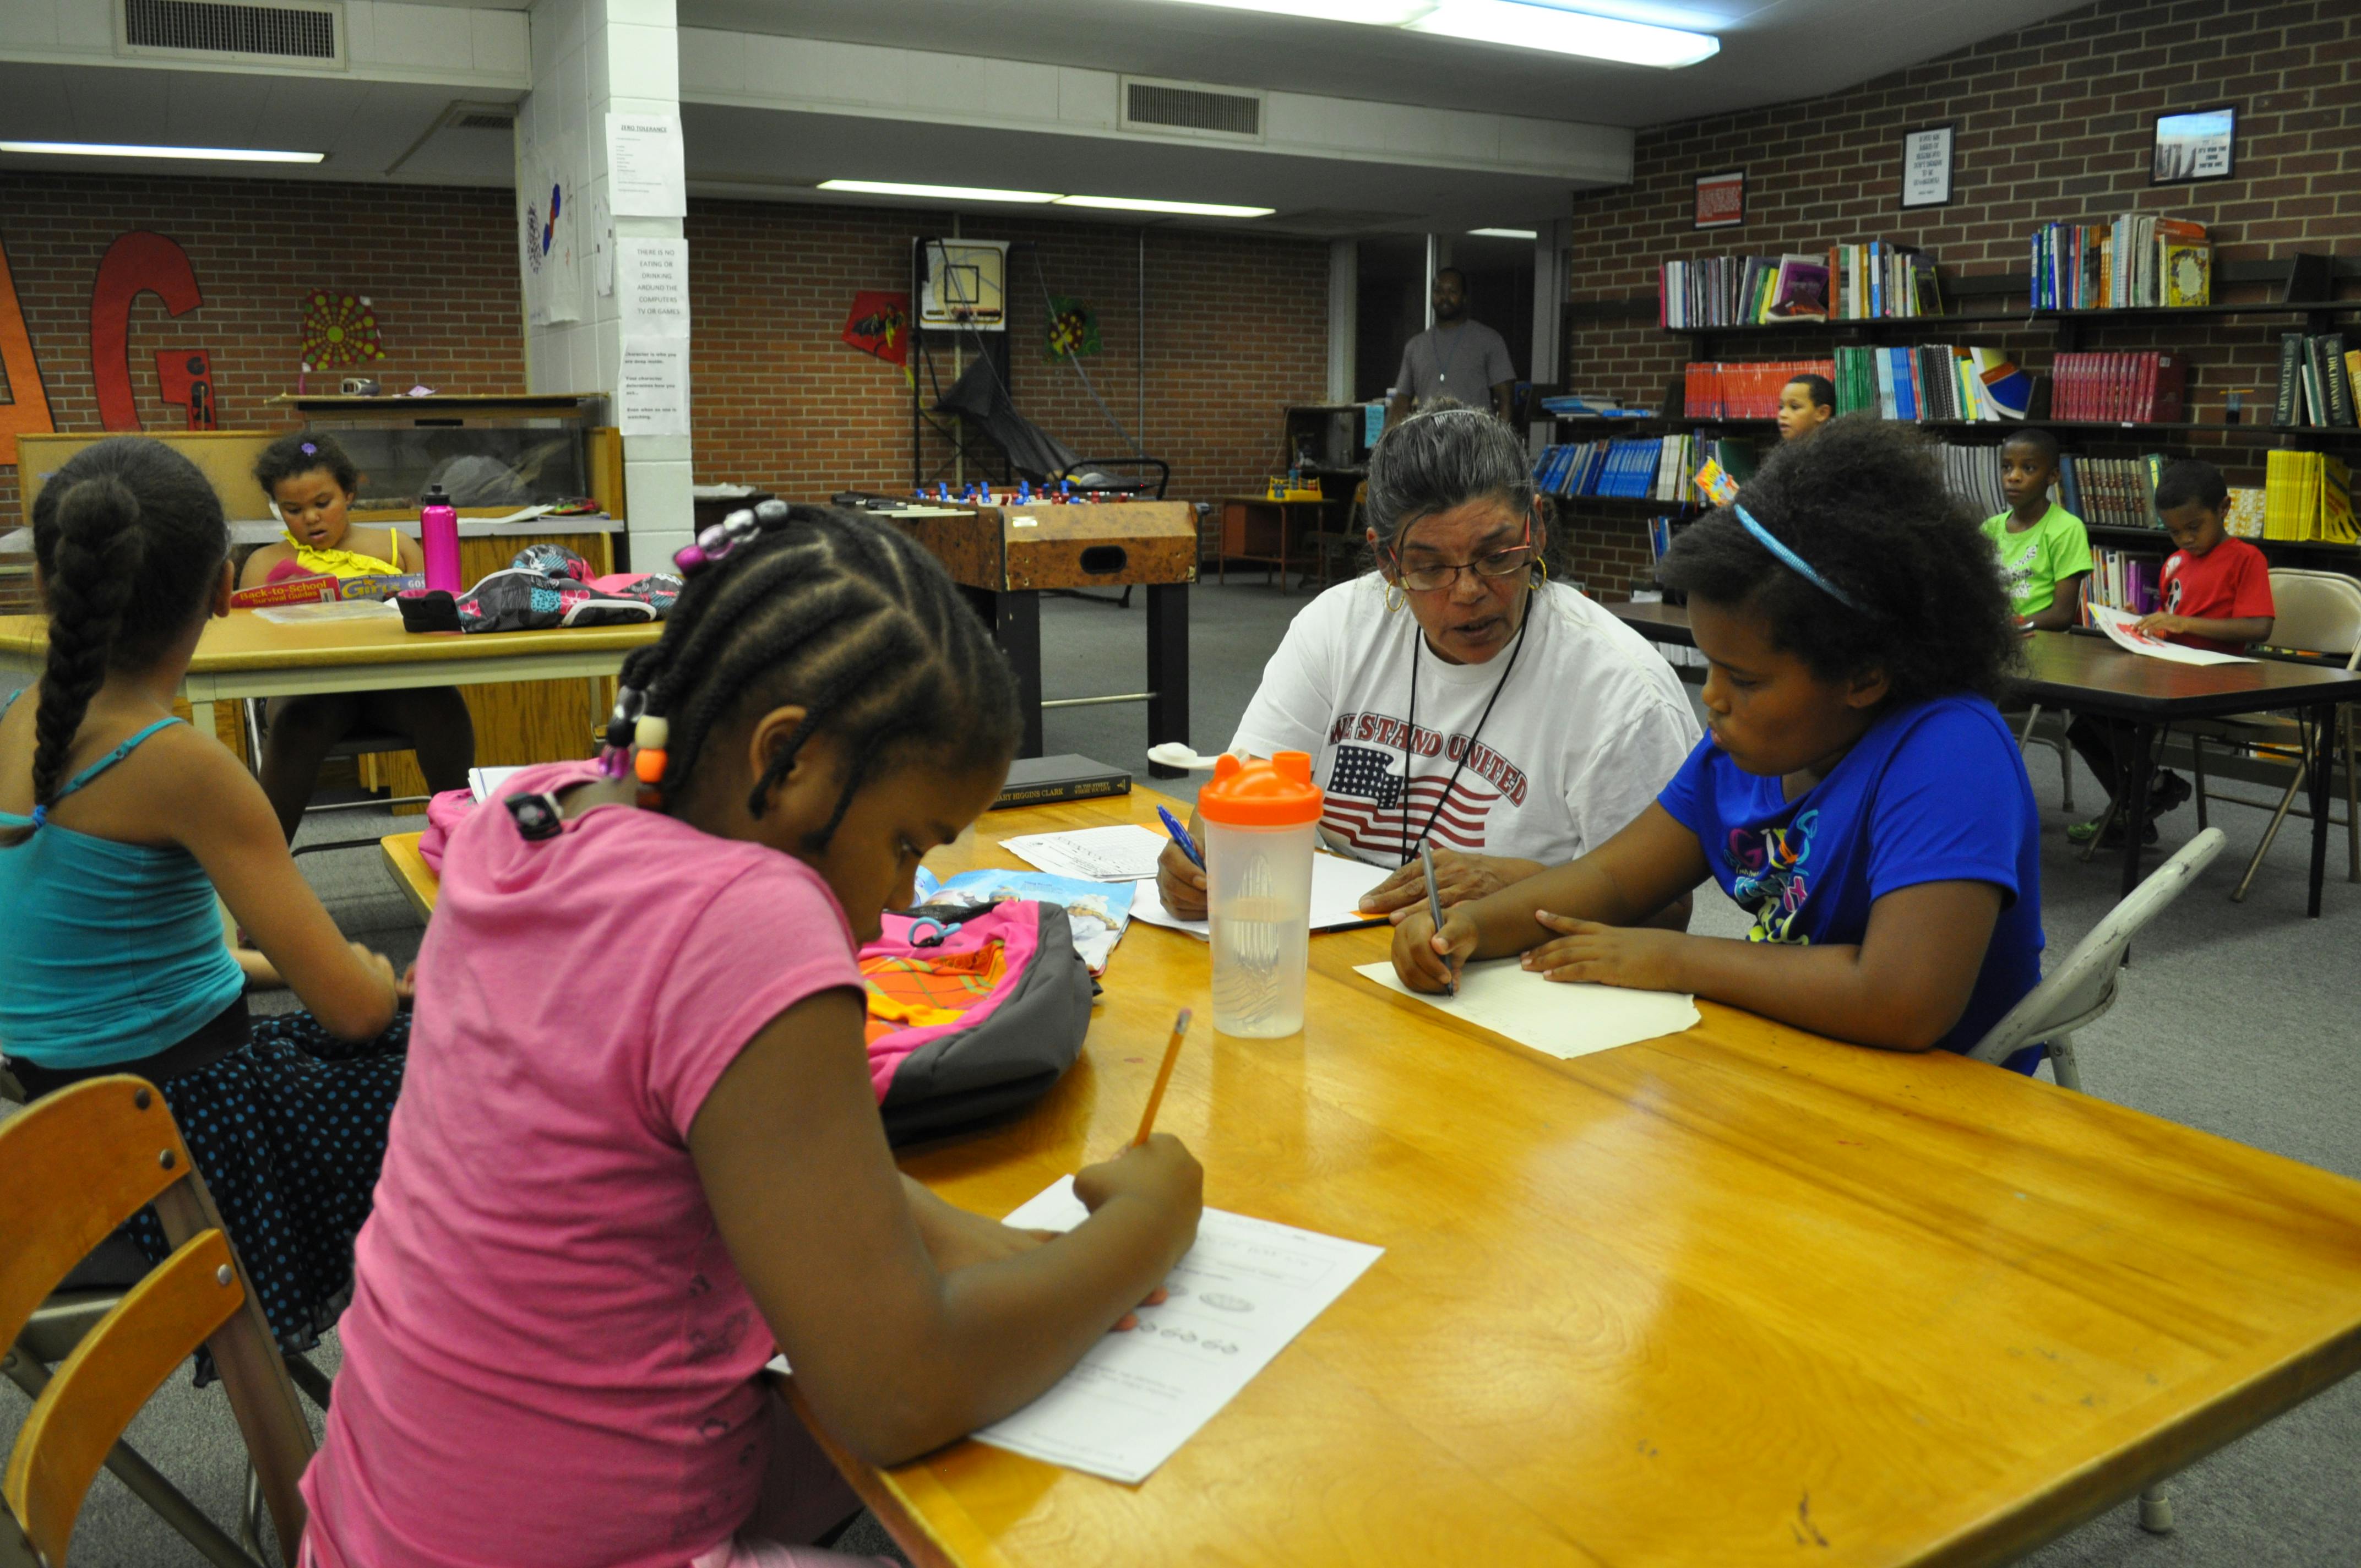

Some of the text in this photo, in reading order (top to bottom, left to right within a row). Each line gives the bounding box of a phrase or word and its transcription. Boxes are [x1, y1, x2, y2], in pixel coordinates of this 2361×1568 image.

[240, 580, 327, 601] Back-to-School
[252, 590, 318, 605] Survival Guides
[1354, 711, 1444, 757] STAND
[1445, 733, 1528, 808] UNITED
[1013, 790, 1040, 801] HIGGINS
[1041, 788, 1063, 797] CLARK
